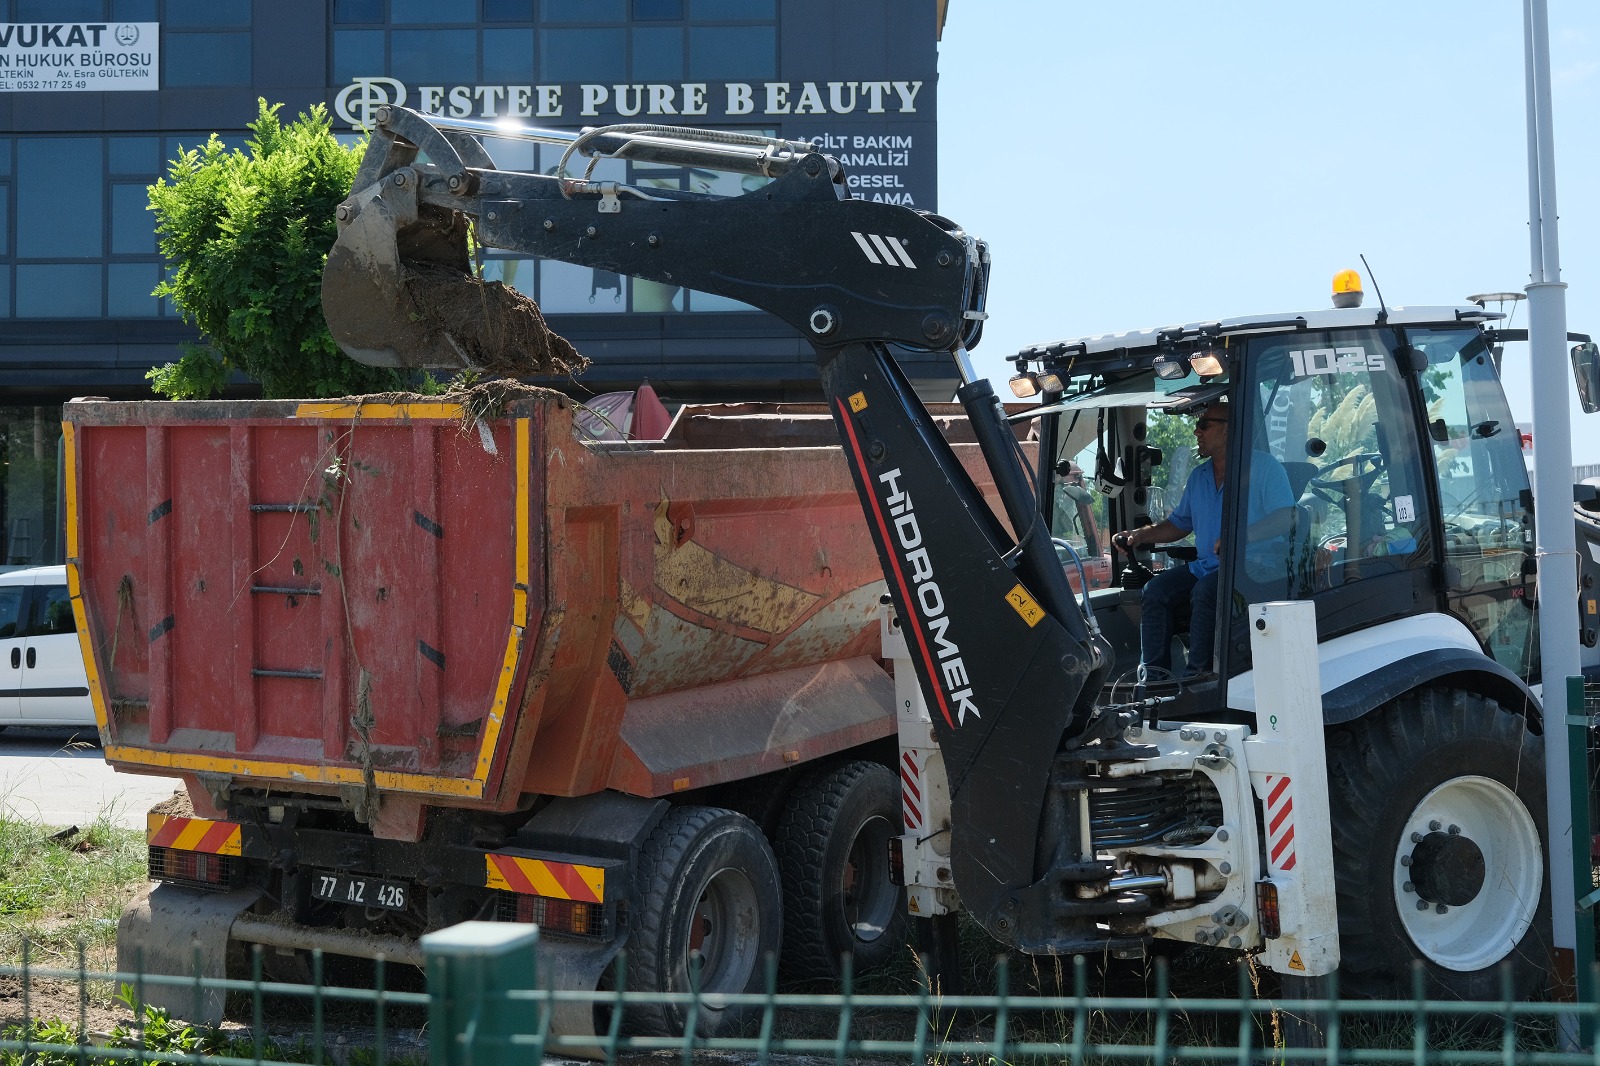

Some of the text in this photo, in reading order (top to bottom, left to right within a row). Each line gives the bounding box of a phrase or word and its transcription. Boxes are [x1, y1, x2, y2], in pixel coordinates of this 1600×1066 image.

[15, 53, 76, 67] HUKUK
[80, 49, 152, 67] BÜROSU
[56, 69, 71, 78] Av.
[74, 69, 96, 78] Esra
[98, 67, 149, 78] GÜLTEKİN
[17, 80, 39, 90] 0532
[42, 80, 59, 89] 717
[61, 80, 73, 89] 25
[75, 80, 87, 89] 49
[418, 80, 923, 118] ESTEE PURE BEAUTY
[853, 135, 913, 149] BAKIM
[840, 150, 909, 167] ANALİZİ
[847, 174, 905, 188] GESEL
[320, 876, 404, 907] 77 AZ 426
